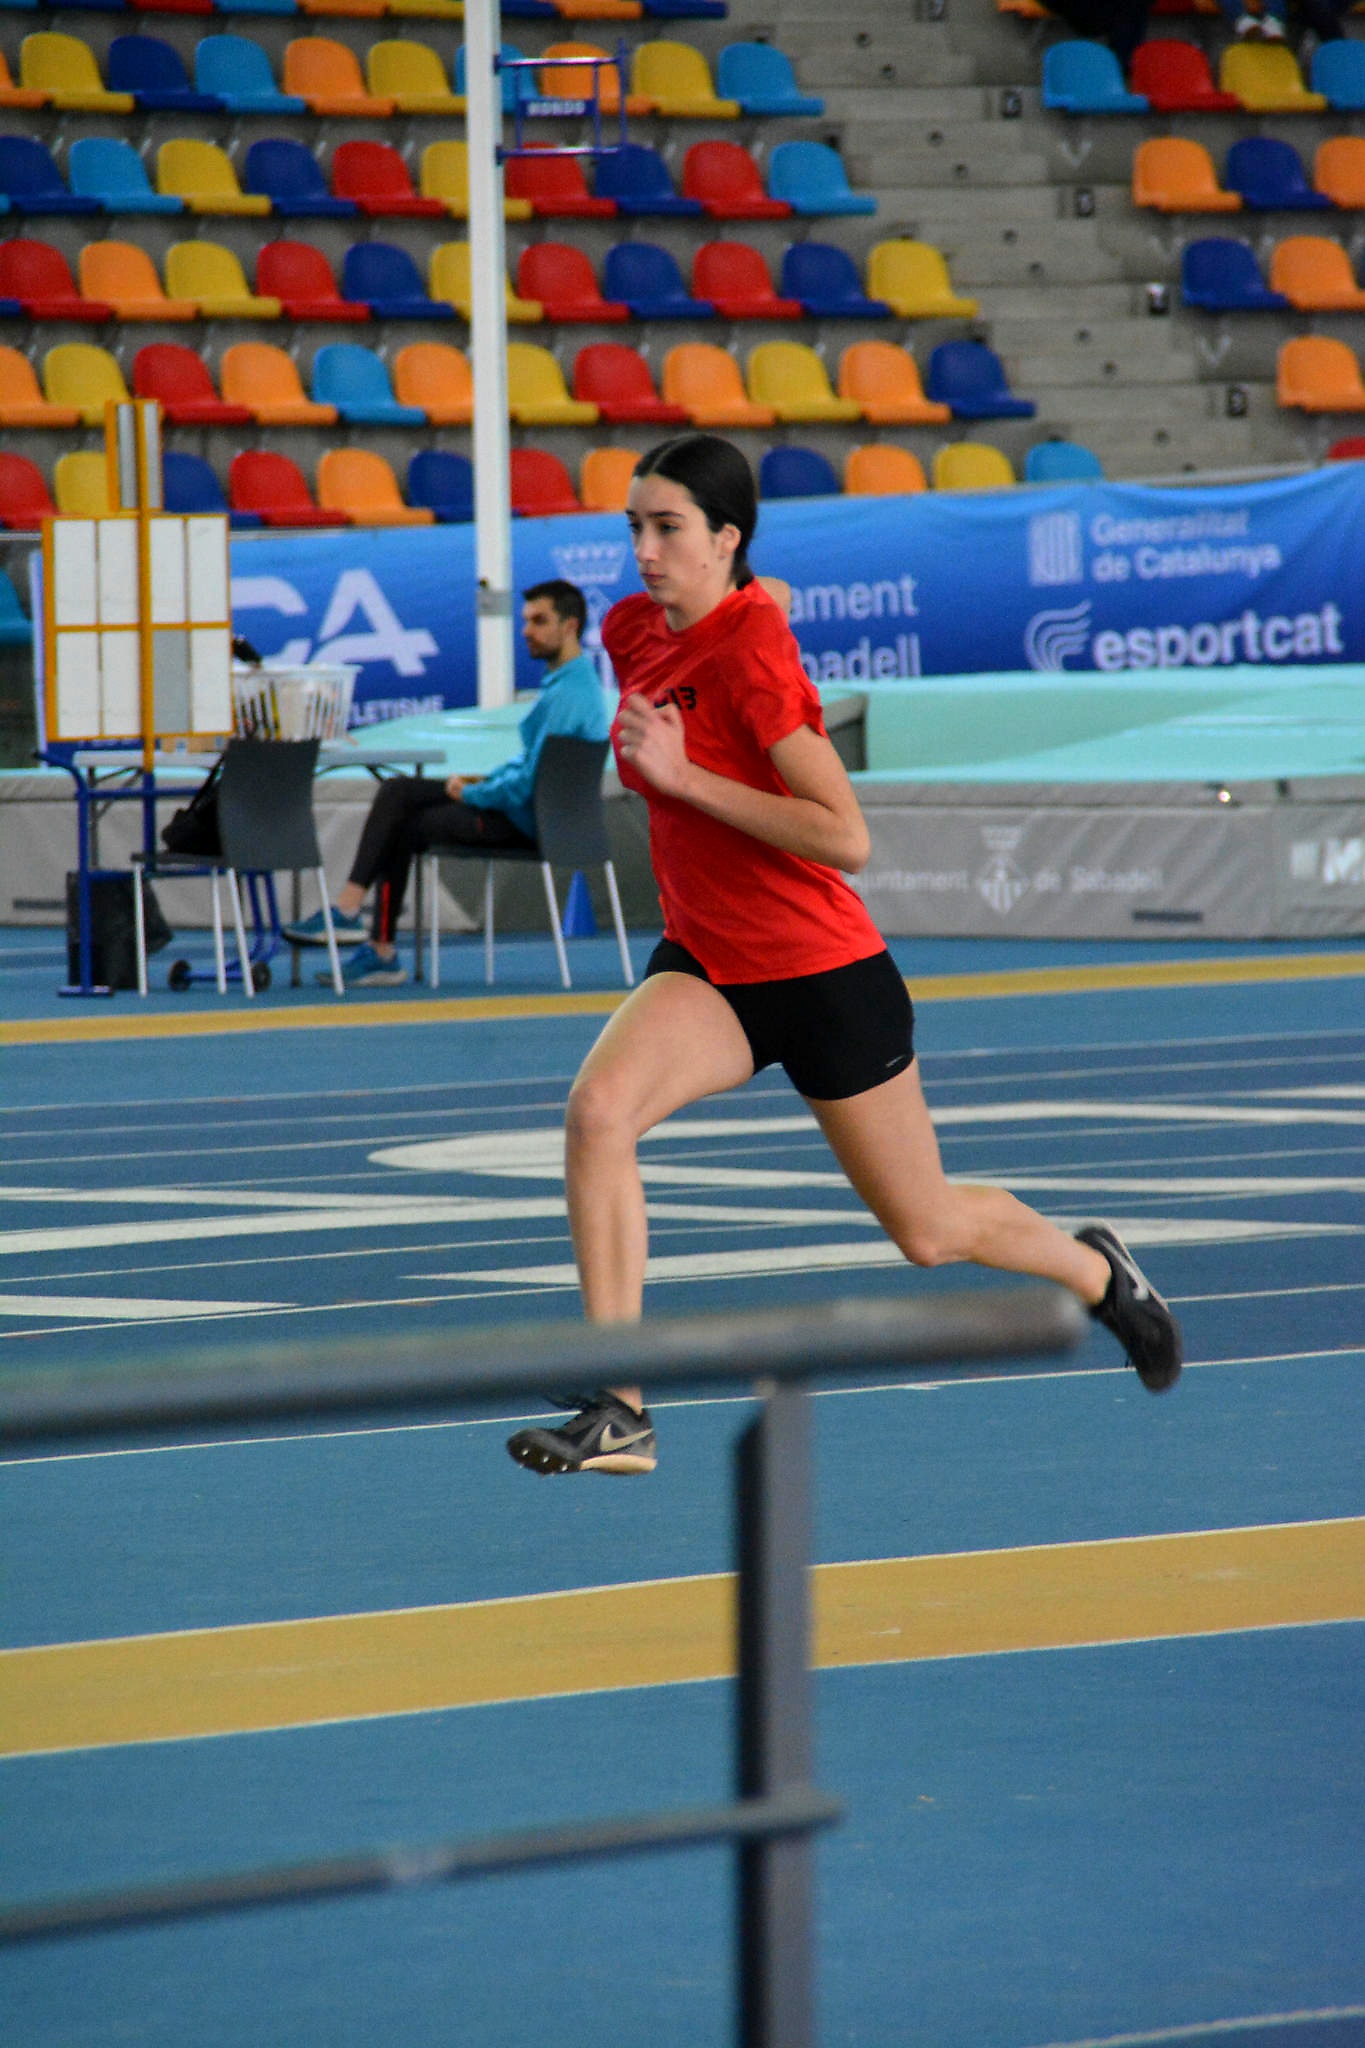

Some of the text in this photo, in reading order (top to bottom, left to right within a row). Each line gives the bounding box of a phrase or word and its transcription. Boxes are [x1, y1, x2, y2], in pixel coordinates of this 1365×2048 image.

[1090, 511, 1249, 546] Generalitat
[1092, 543, 1282, 582] de Catalunya
[790, 573, 919, 624] ament
[1094, 602, 1344, 671] esportcat
